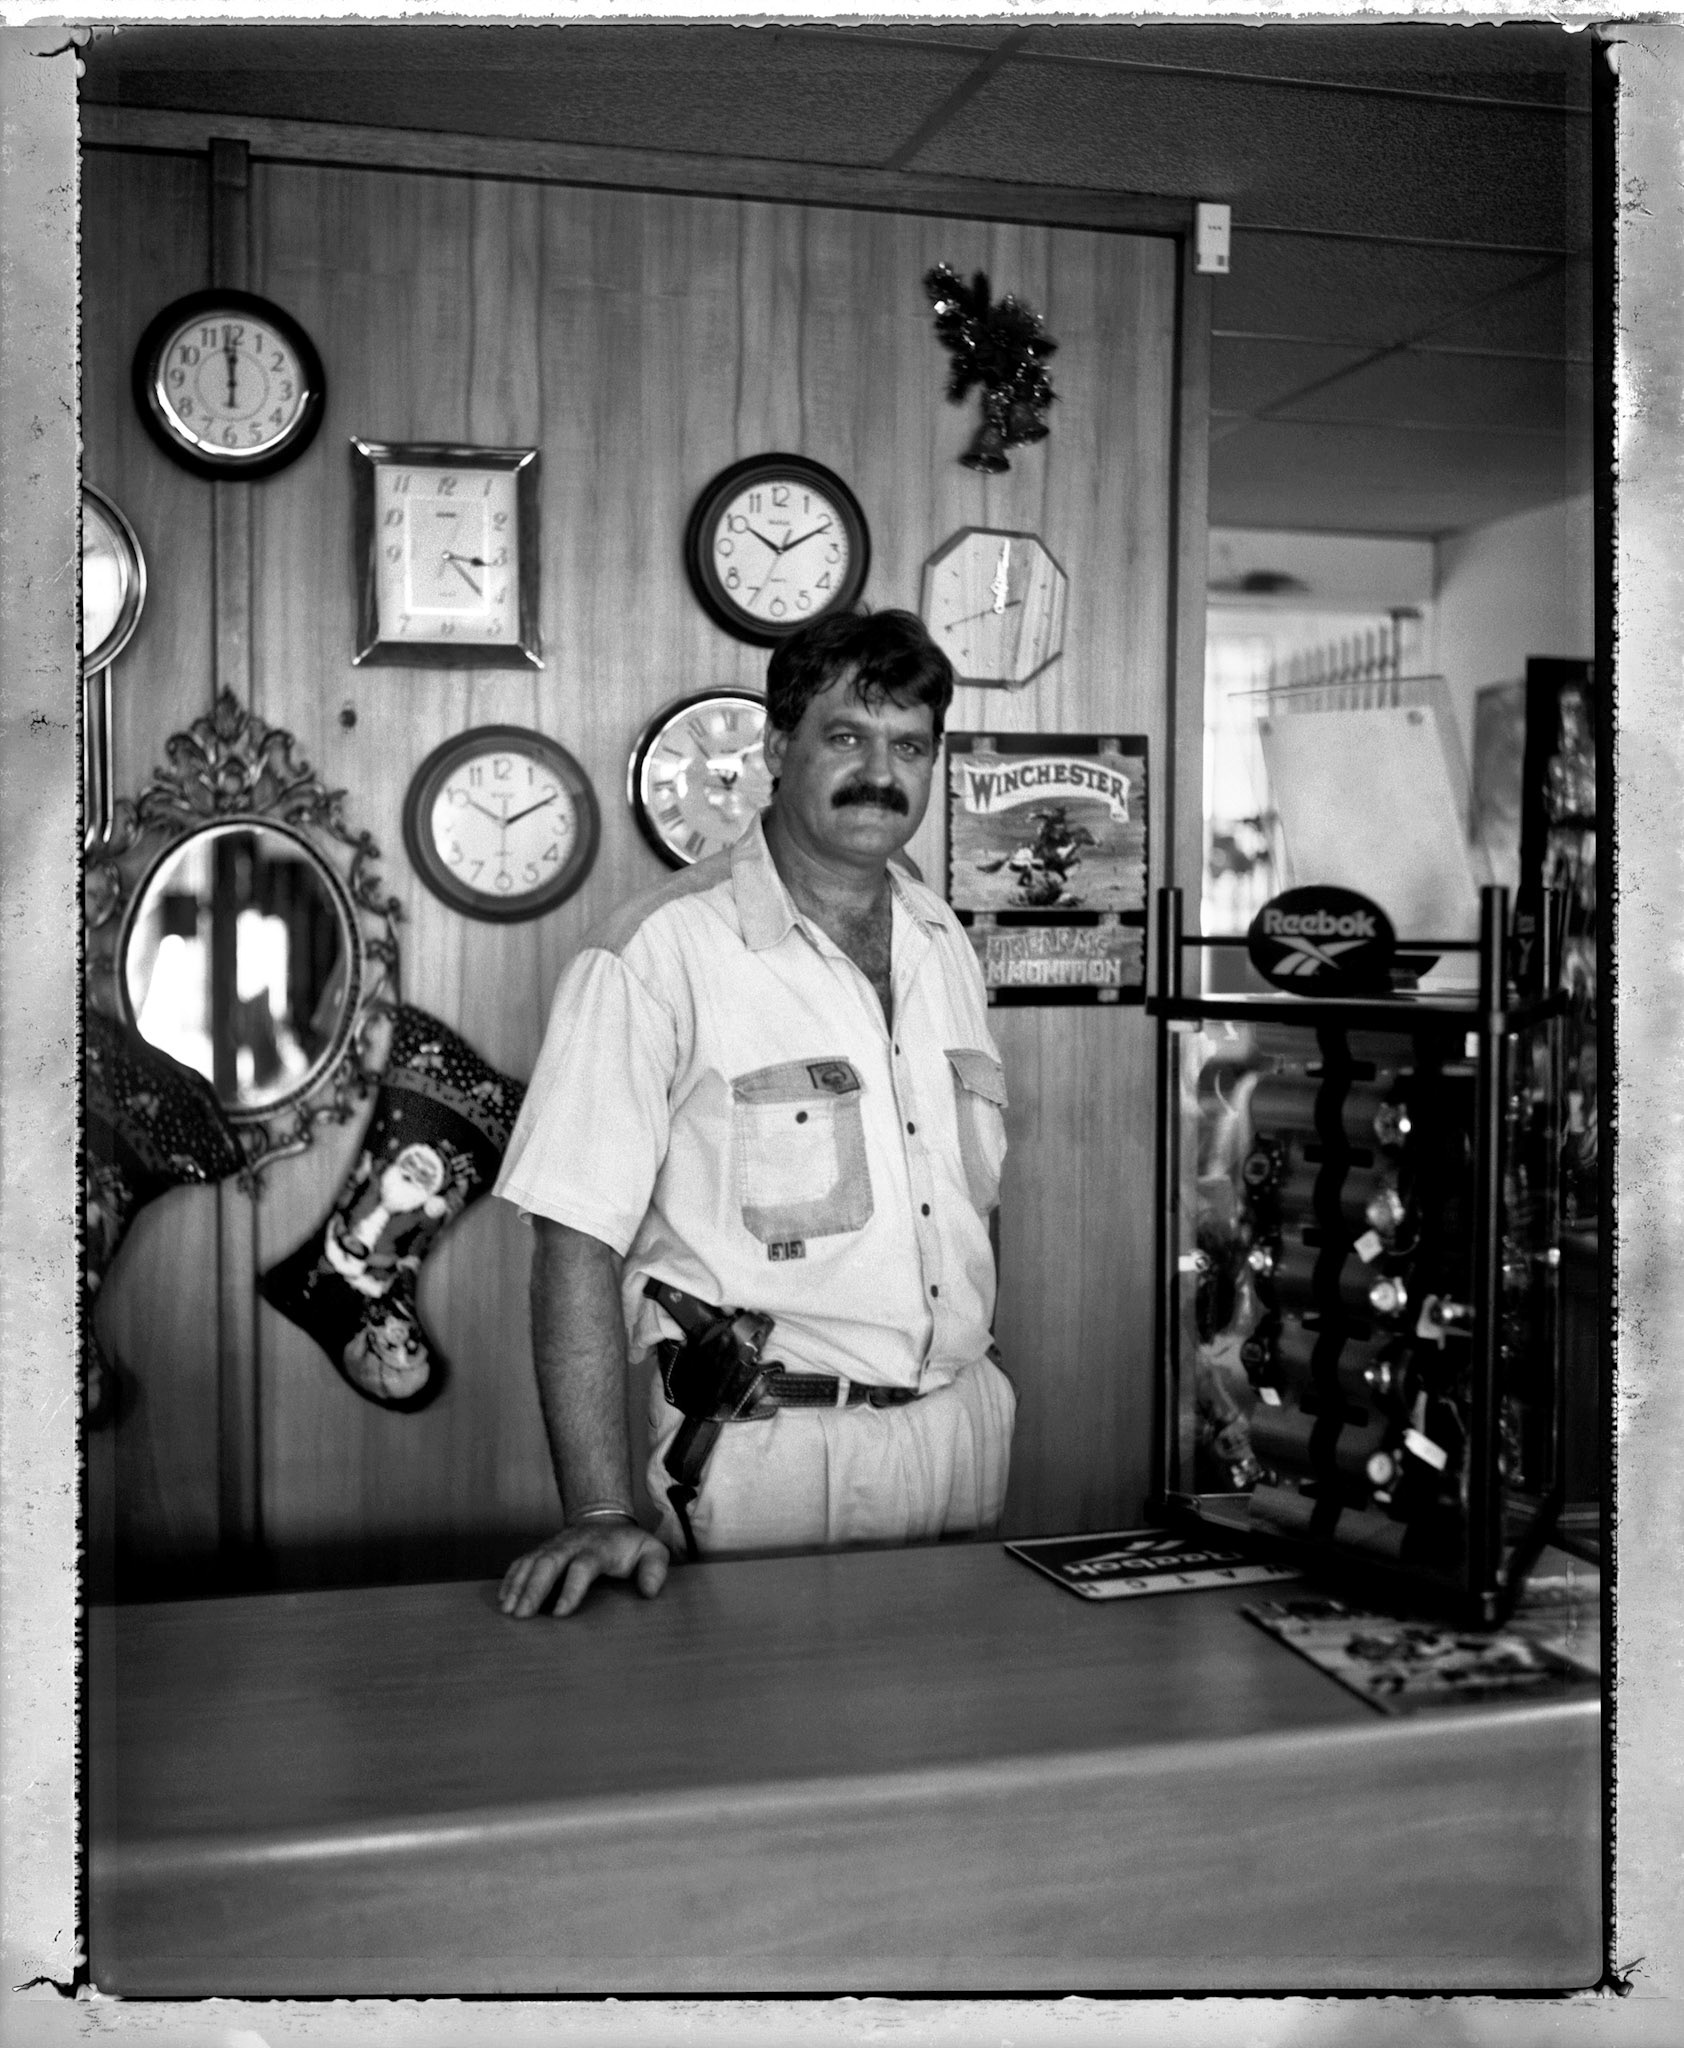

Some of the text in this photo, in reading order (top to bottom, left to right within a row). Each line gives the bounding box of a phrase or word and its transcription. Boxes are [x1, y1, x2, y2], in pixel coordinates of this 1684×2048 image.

[202, 327, 217, 348] 11
[255, 332, 263, 354] 1
[180, 345, 200, 367] 10
[271, 350, 285, 372] 2
[169, 367, 186, 389] 9
[280, 379, 293, 402] 3
[178, 395, 194, 418] 8
[268, 406, 283, 427] 4
[202, 414, 215, 438] 7
[222, 424, 238, 447] 6
[249, 421, 263, 443] 5
[393, 474, 412, 494] 11
[436, 475, 458, 497] 12
[483, 479, 493, 497] 1
[749, 492, 761, 514] 11
[772, 485, 790, 508] 12
[803, 494, 810, 515] 1
[727, 513, 749, 534] 10
[717, 537, 734, 558] 9
[825, 541, 840, 564] 3
[725, 566, 741, 590] 8
[814, 571, 831, 590] 4
[746, 586, 761, 607] 7
[769, 595, 788, 618] 6
[796, 589, 812, 611] 5
[469, 766, 482, 787] 11
[494, 758, 513, 781] 12
[528, 766, 535, 786] 1
[446, 787, 471, 809] 10
[967, 764, 1126, 810] WINCHESTER
[552, 813, 569, 837] 3
[541, 842, 559, 862] 4
[470, 860, 485, 882] 7
[494, 868, 514, 891] 6
[522, 861, 540, 884] 5
[1263, 908, 1377, 938] Reebok
[1062, 1551, 1244, 1575] Reebok
